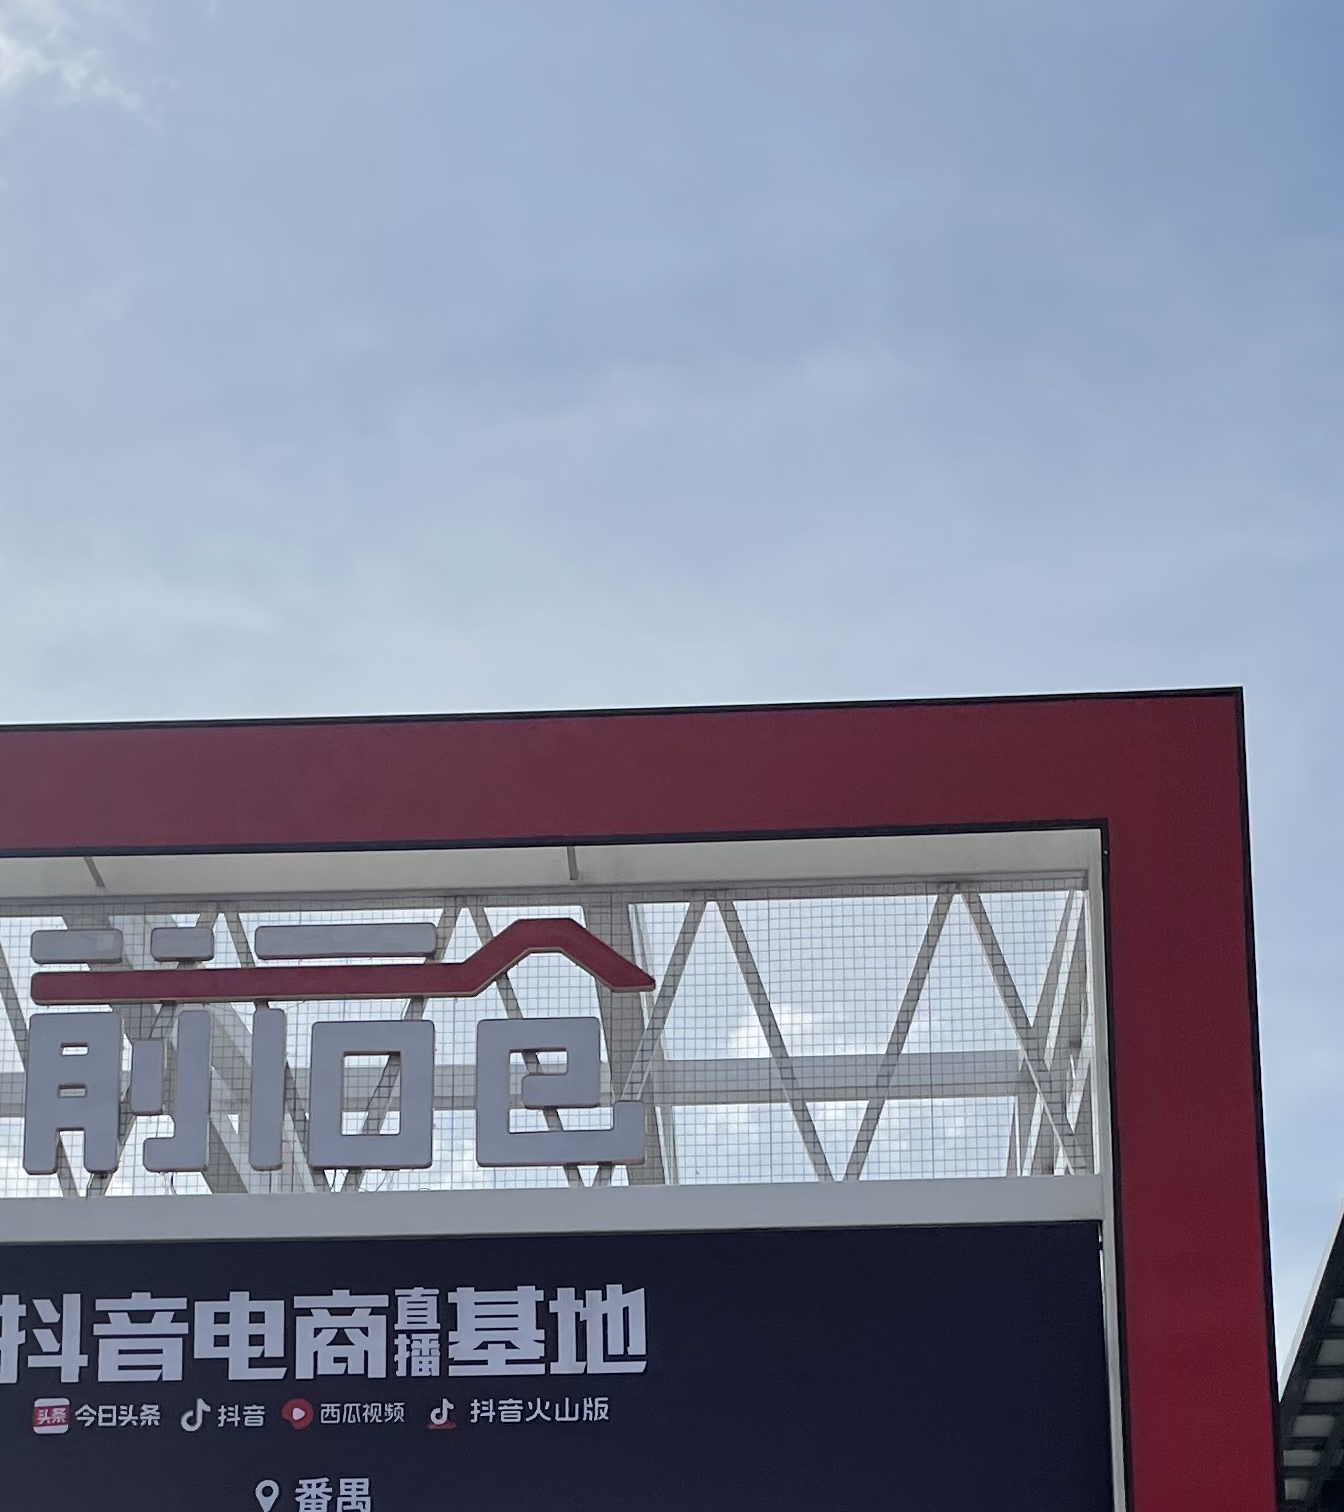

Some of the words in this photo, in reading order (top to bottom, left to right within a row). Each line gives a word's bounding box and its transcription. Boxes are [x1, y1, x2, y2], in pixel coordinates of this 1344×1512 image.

[75, 1403, 161, 1428] 今日头条
[217, 1404, 266, 1428] 抖音
[320, 1402, 405, 1424] 西瓜视频
[470, 1397, 610, 1423] 抖音火山版
